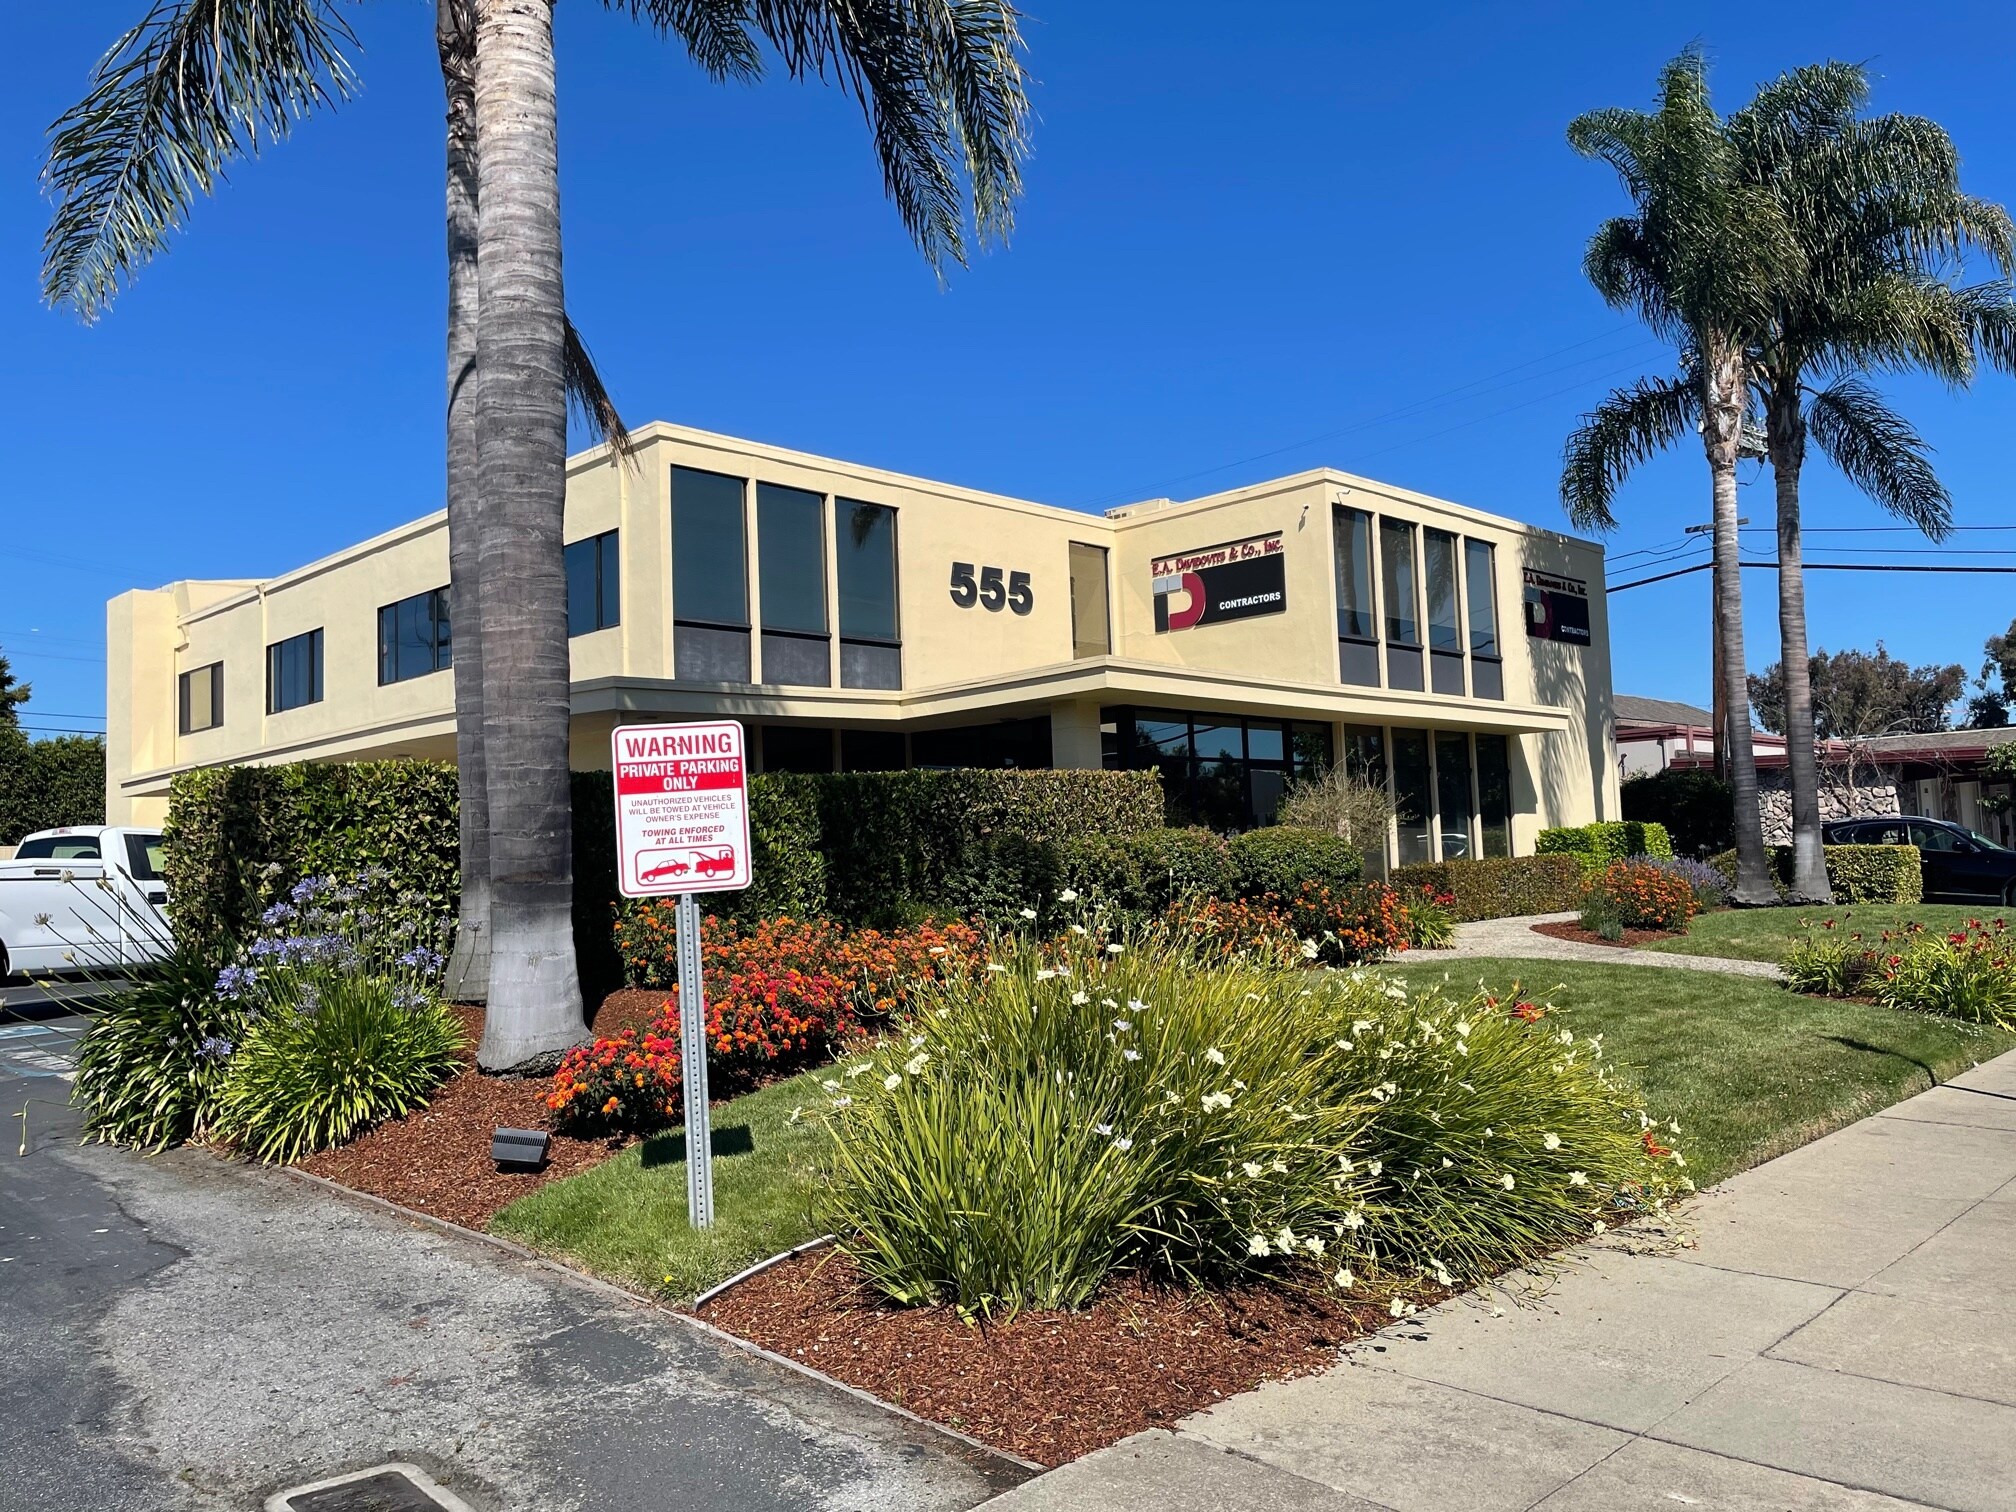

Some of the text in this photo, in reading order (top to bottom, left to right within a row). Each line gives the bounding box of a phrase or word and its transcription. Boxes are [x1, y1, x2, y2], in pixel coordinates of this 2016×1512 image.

[1152, 561, 1173, 577] E.A.
[1229, 547, 1238, 560] &
[950, 562, 1033, 616] 555
[1220, 592, 1281, 610] CONTRACTORS
[1561, 625, 1588, 636] CONTRACTORS
[626, 734, 731, 758] WARNING
[620, 759, 739, 778] PRIVATE PARKING
[663, 776, 698, 790] ONLY
[631, 797, 692, 806] UNAUTHORIZED
[646, 812, 719, 823] OWNER'S EXPENSE
[642, 825, 724, 837] TOWING ENFORCED
[669, 836, 684, 844] ALL
